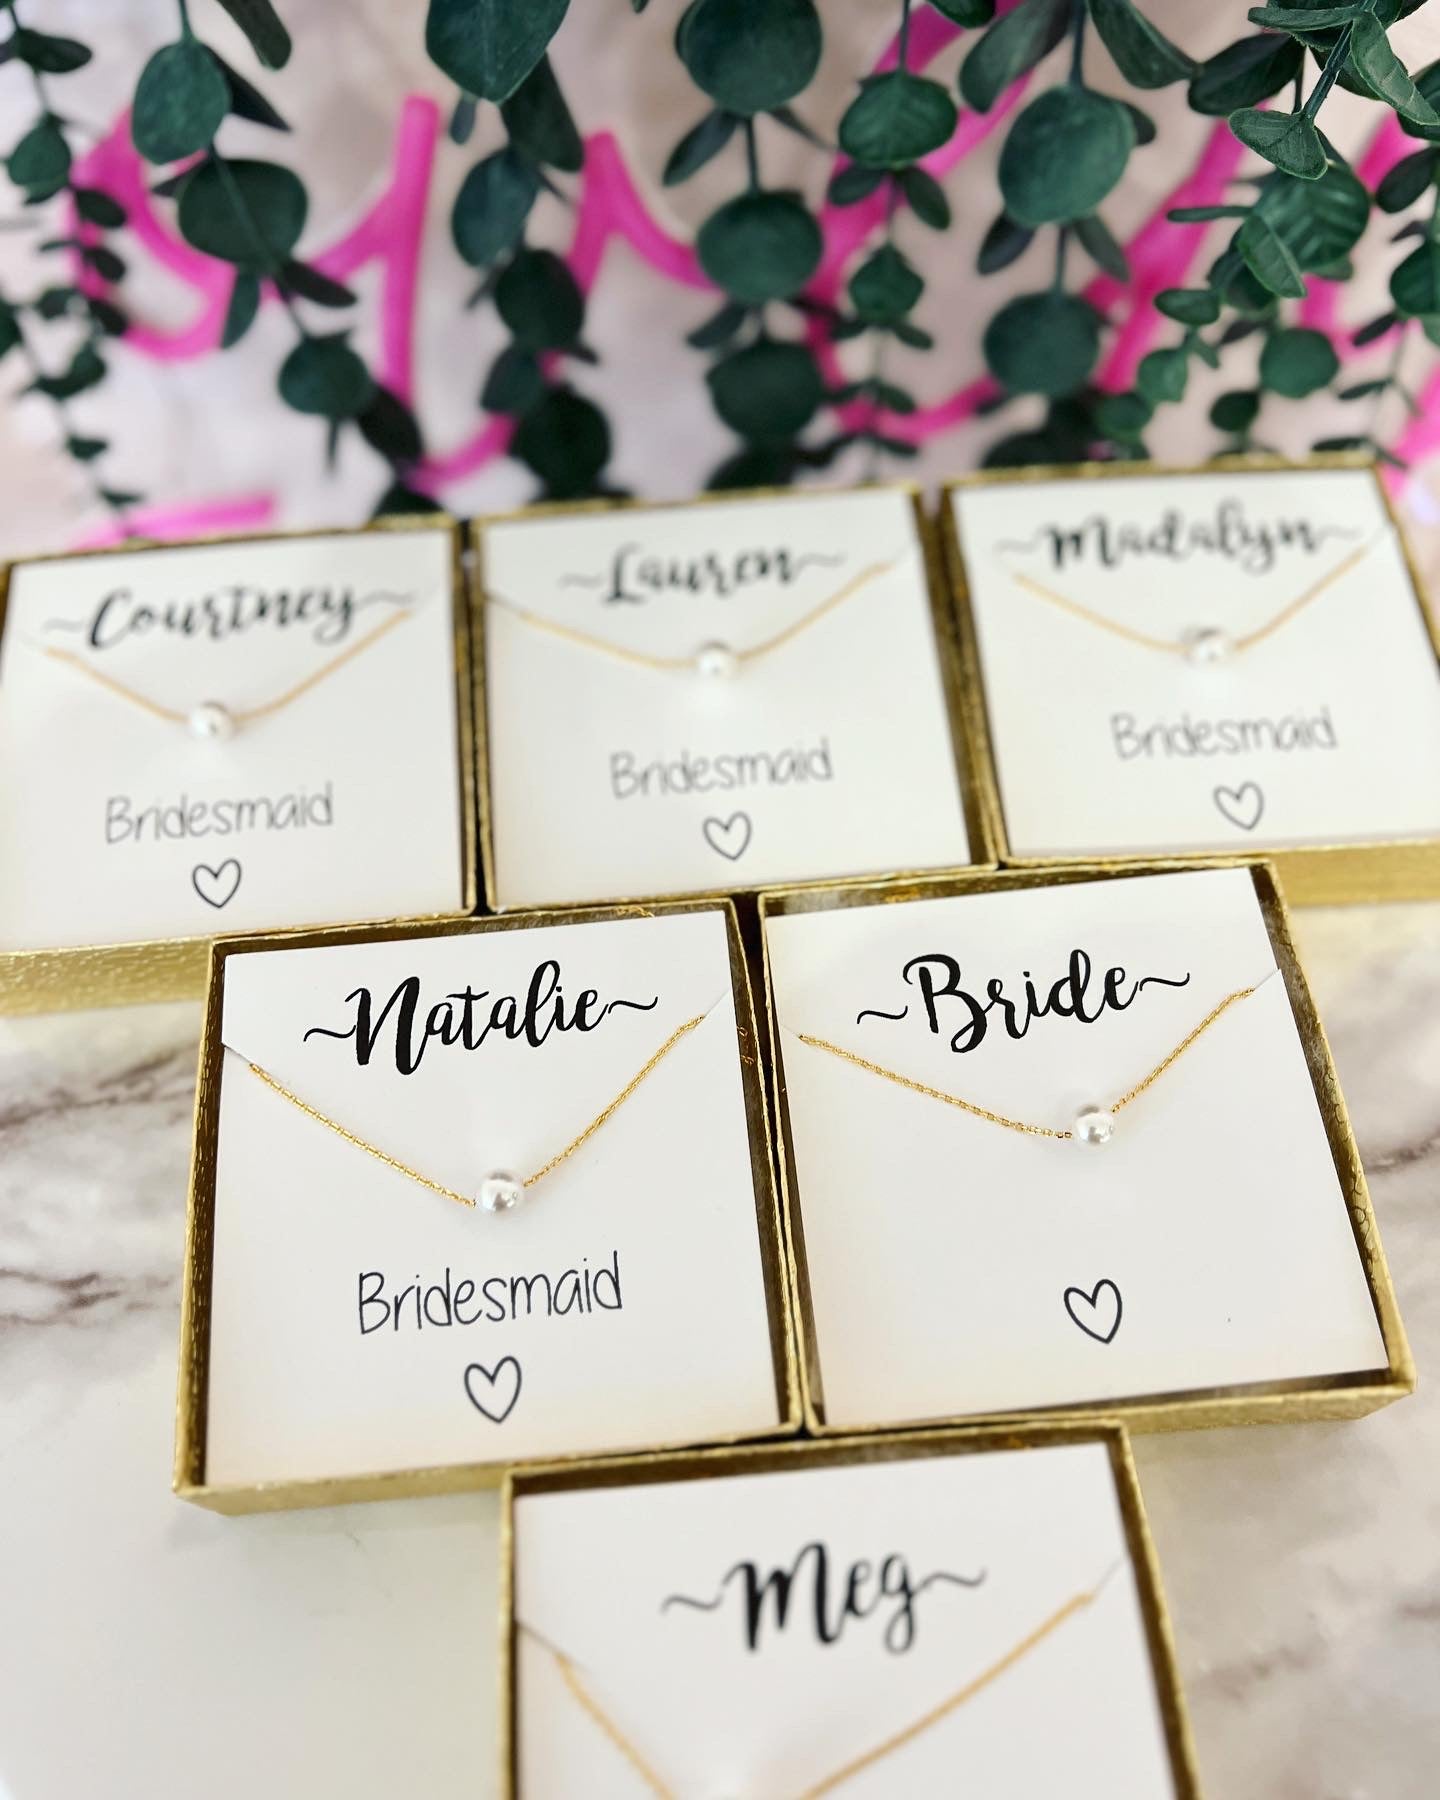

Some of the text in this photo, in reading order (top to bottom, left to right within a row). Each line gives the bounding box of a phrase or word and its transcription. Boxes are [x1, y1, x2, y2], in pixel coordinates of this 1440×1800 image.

[1040, 499, 1320, 574] Madalyn
[602, 543, 797, 604] Lauren
[86, 585, 359, 649] Courtney
[610, 737, 834, 799] Bridesmaid
[1110, 706, 1338, 761] Bridesmaid
[106, 782, 333, 844] Bridesmaid
[340, 960, 612, 1075] Natalie
[900, 949, 1143, 1053] Bride
[358, 1250, 623, 1335] Bridesmaid
[716, 1541, 928, 1655] Meg
